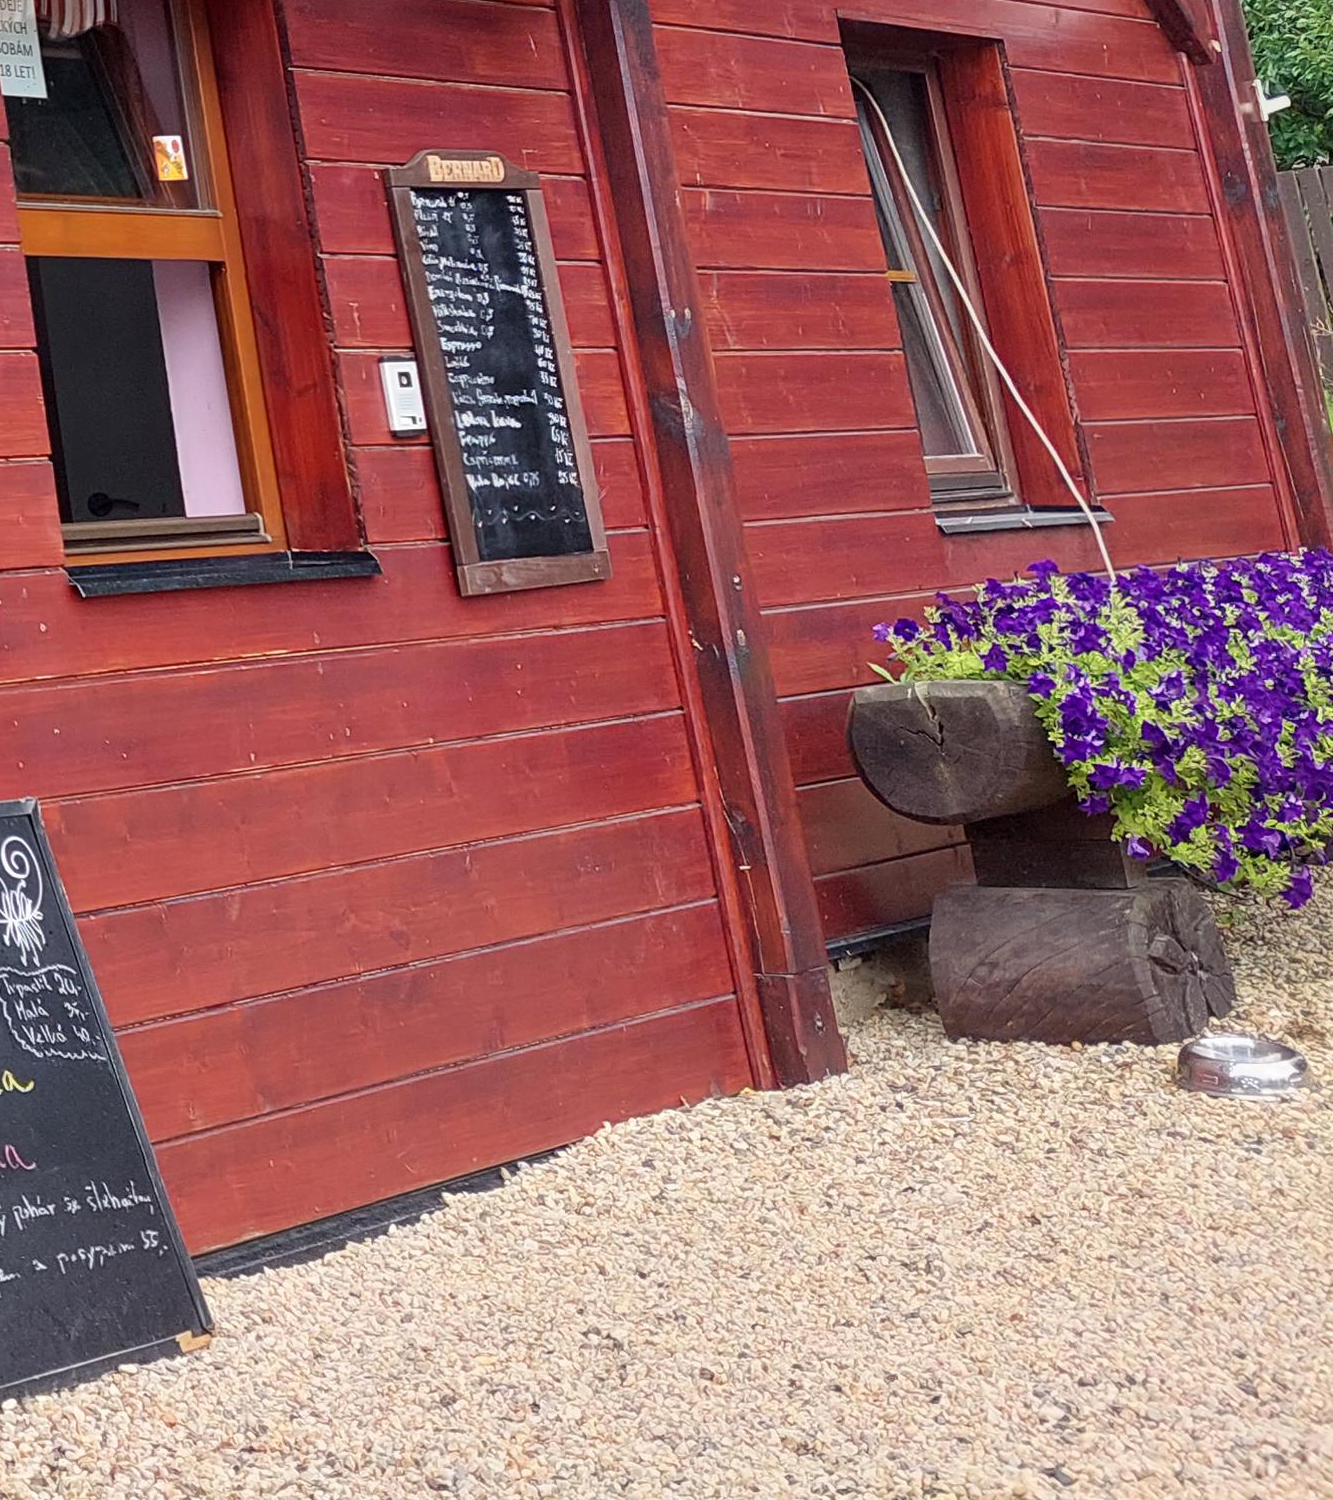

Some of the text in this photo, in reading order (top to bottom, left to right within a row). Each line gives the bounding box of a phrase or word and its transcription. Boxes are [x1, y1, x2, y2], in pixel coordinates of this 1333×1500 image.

[0, 64, 36, 80] 18 LET!
[426, 155, 504, 182] BERNARD
[14, 997, 50, 1021] Malá
[12, 1194, 57, 1231] pohár
